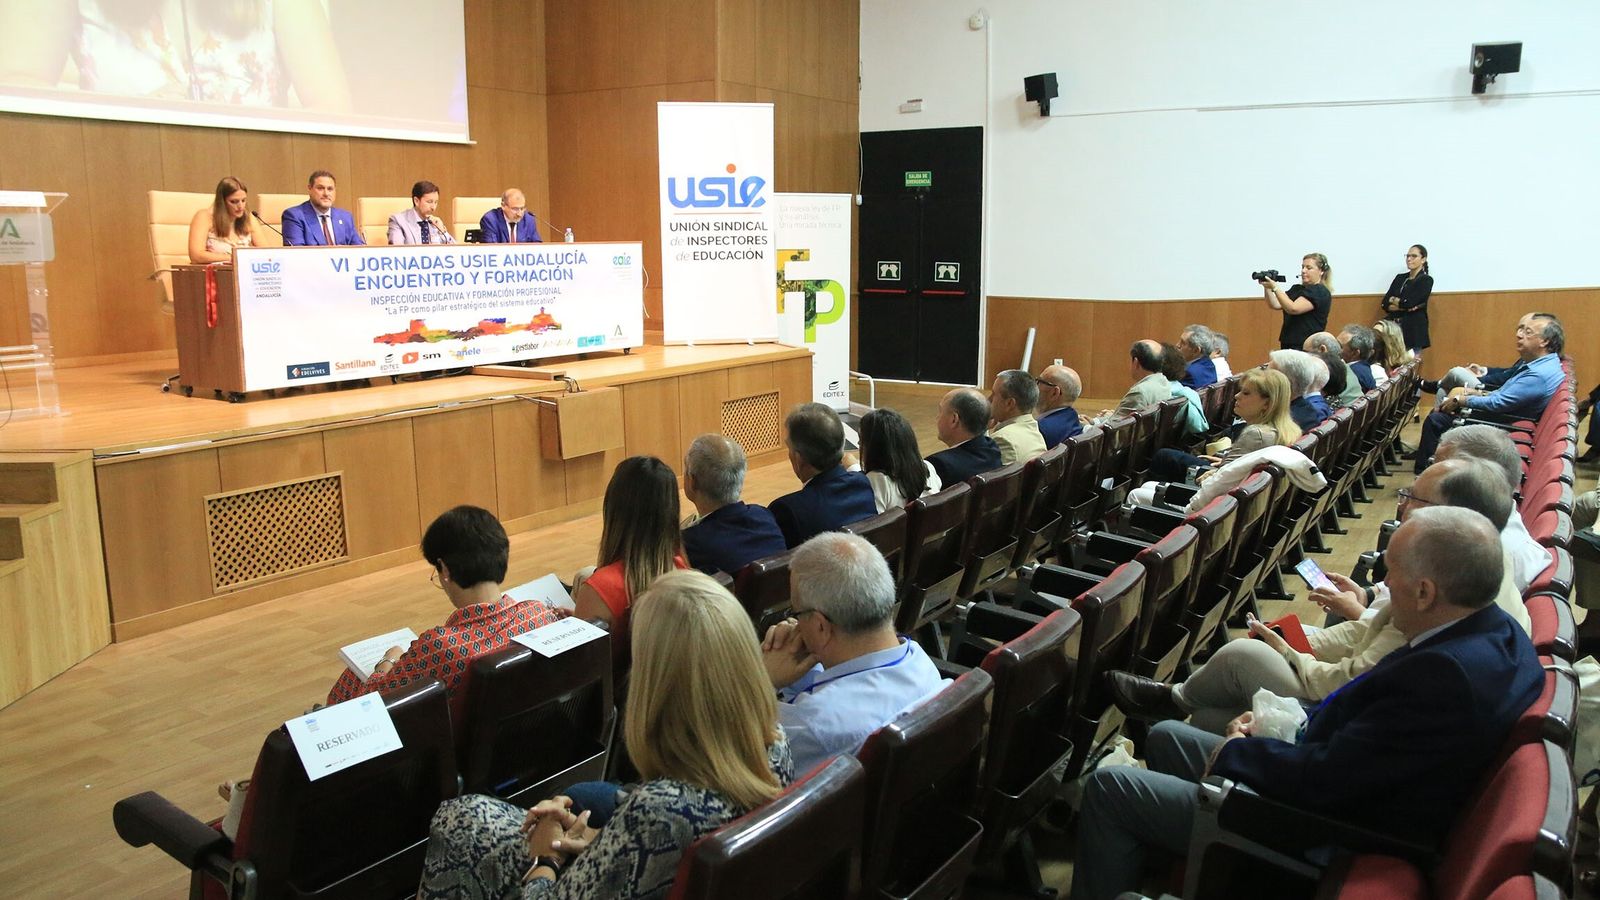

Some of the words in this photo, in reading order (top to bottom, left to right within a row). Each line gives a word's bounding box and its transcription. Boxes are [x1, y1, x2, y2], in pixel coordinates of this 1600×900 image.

[667, 163, 766, 209] usie
[670, 219, 710, 232] UNIÓN
[713, 221, 769, 232] SINDICAL
[670, 236, 685, 247] de
[687, 236, 768, 247] INSPECTORES
[330, 257, 349, 273] VI
[356, 255, 455, 273] JORNADAS
[460, 253, 498, 269] USIE
[503, 249, 588, 267] ANDALUCÍA
[675, 252, 690, 262] de
[692, 247, 764, 262] EDUCACIÓN
[251, 258, 281, 273] usie
[355, 271, 465, 291] ENCUENTRO
[470, 271, 480, 285] Y
[485, 265, 574, 285] FORMACIÓN
[370, 292, 421, 305] INSPECCIÓN
[422, 291, 465, 303] EDUCATIVA
[465, 291, 472, 300] Y
[472, 286, 515, 300] FORMACIÓN
[516, 286, 562, 298] PROFESIONAL
[399, 305, 410, 315] FP
[411, 306, 431, 315] como
[431, 303, 448, 315] pilar
[449, 300, 487, 313] estratégico
[488, 299, 499, 309] del
[499, 299, 525, 309] sistema
[422, 352, 441, 360] sm
[301, 368, 326, 377] EDELVIVES
[335, 359, 377, 371] Santillana
[541, 626, 586, 646] RESERVADO
[315, 723, 381, 753] RESERVADO
